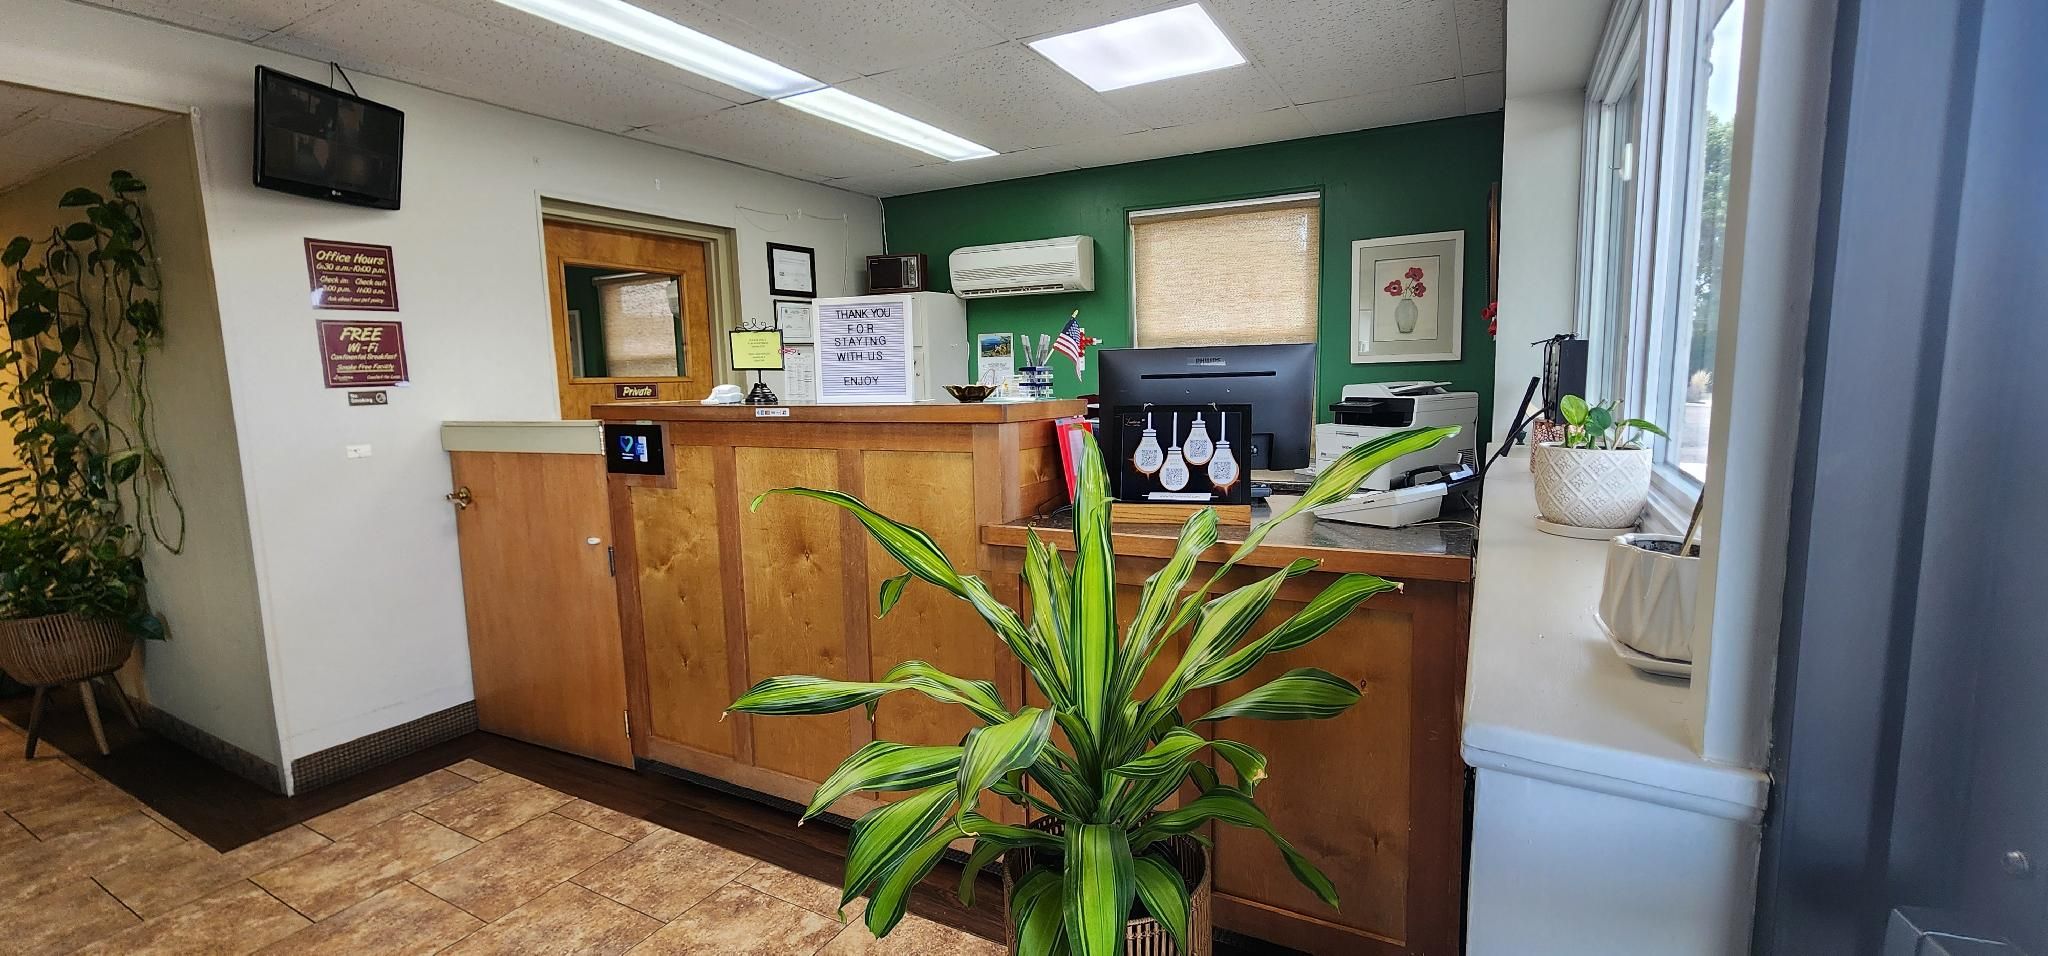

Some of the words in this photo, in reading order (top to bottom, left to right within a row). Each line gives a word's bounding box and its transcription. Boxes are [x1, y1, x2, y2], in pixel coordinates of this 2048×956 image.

[316, 250, 351, 263] Office
[353, 253, 385, 265] Hours
[320, 275, 339, 284] Check
[355, 278, 373, 286] Check
[836, 309, 869, 319] THANK
[870, 308, 891, 318] YOU
[847, 323, 874, 334] FOR
[340, 327, 383, 341] FREE
[834, 335, 887, 346] STAYING
[347, 342, 379, 353] Wi-Fi
[331, 353, 366, 361] Continental
[836, 351, 863, 361] WITH
[868, 351, 883, 360] US
[843, 376, 879, 386] ENJOY
[622, 386, 652, 396] Private
